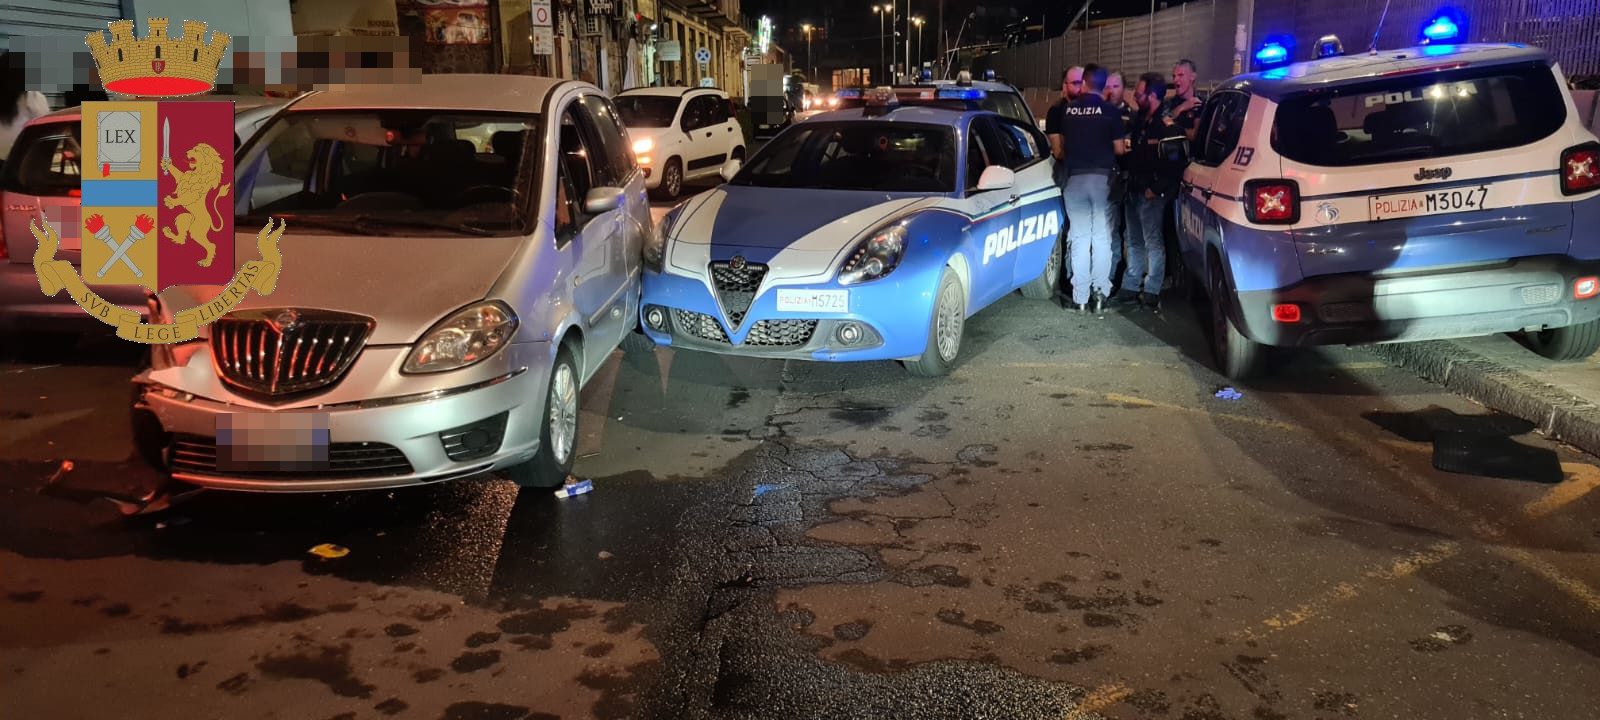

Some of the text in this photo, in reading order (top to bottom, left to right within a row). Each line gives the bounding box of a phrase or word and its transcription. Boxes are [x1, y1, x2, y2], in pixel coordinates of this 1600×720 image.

[1066, 106, 1102, 115] POLIZIA
[1375, 184, 1488, 214] POLIZIA M3047
[982, 210, 1059, 265] POLIZIA
